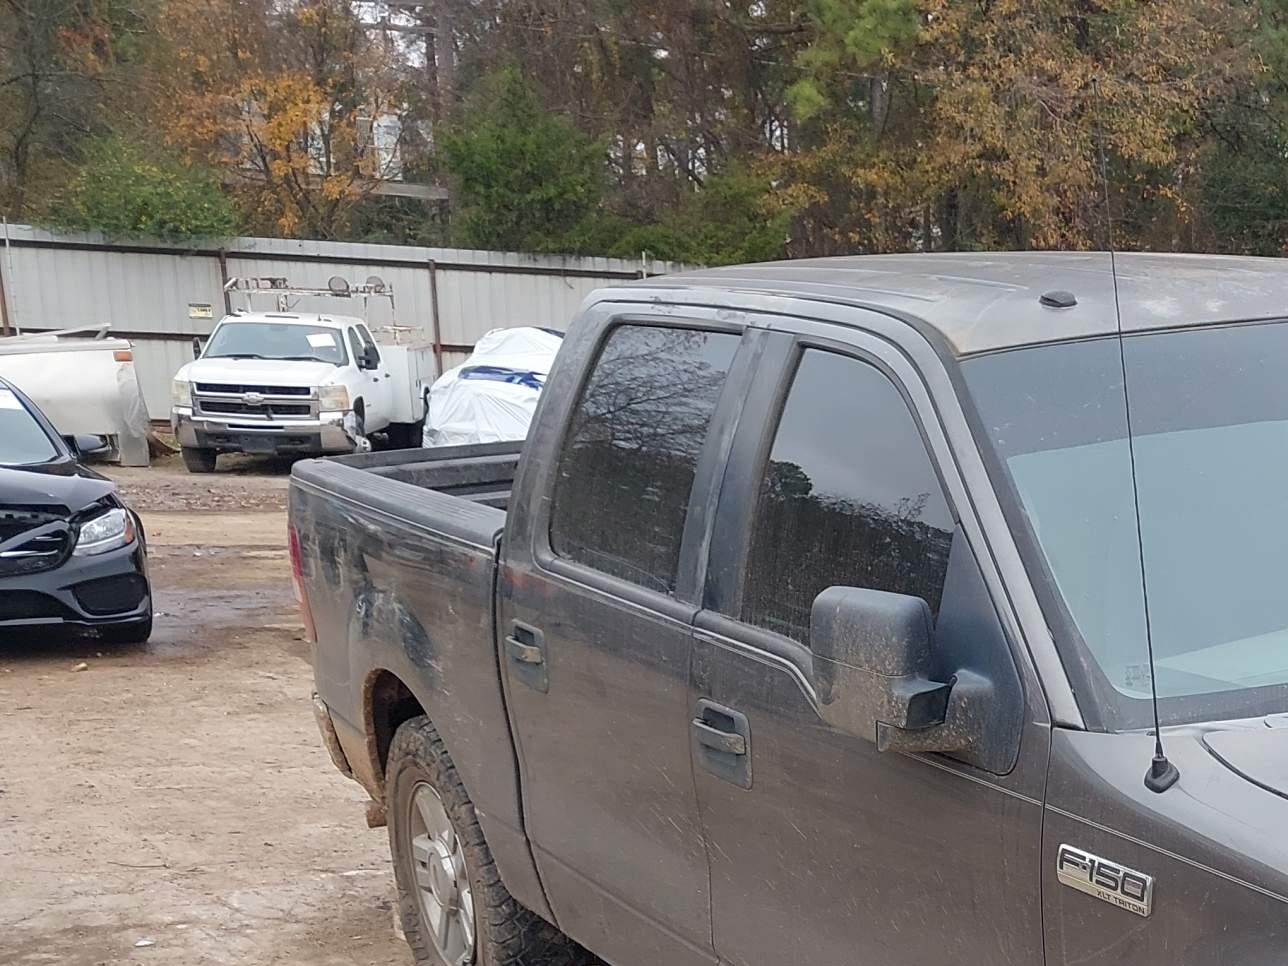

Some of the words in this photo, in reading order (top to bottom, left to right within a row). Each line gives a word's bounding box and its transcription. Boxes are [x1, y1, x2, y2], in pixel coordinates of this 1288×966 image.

[1058, 847, 1148, 902] F-150
[1096, 889, 1112, 901] XLT
[1112, 896, 1146, 915] TRITON
